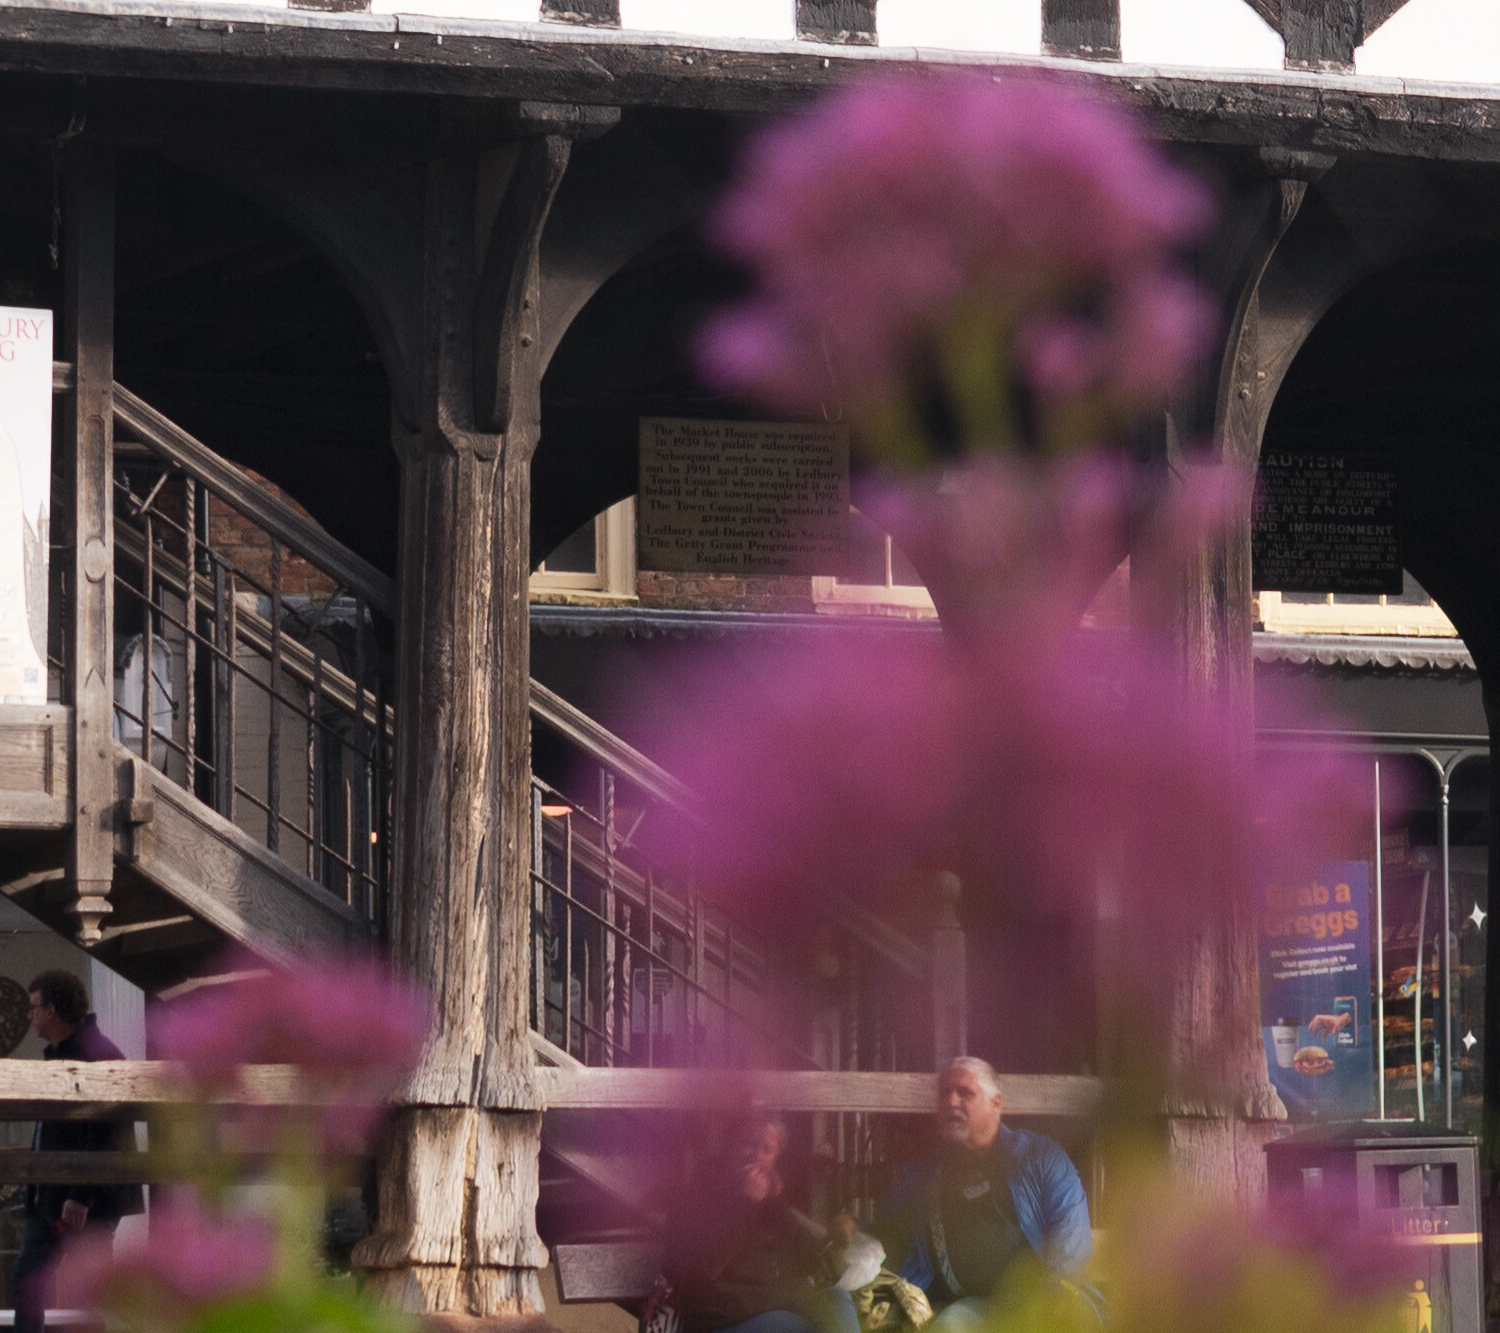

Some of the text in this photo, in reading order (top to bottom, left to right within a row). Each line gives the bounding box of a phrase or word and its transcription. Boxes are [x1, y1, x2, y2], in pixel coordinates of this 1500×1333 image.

[652, 424, 675, 435] The
[680, 426, 720, 438] Market
[724, 428, 759, 439] House
[788, 432, 836, 443] repaired
[655, 435, 667, 446] in
[673, 436, 700, 447] 1939
[704, 438, 716, 450] by
[722, 439, 754, 450] public
[655, 450, 833, 466] Subsequent works were carried
[645, 464, 664, 474] out
[668, 464, 680, 474] in
[686, 464, 711, 475] 1991
[717, 466, 738, 475] and
[743, 466, 773, 477] 2006
[795, 468, 842, 480] Ledbury
[650, 474, 680, 485] Town
[685, 476, 727, 487] Council
[732, 478, 755, 487] who
[645, 485, 682, 496] behalf
[686, 486, 698, 497] of
[702, 488, 719, 498] the
[724, 489, 792, 502] townspeople
[647, 499, 670, 510] The
[675, 500, 705, 511] Town
[709, 502, 752, 513] Council
[758, 506, 776, 514] was
[781, 506, 823, 516] assisted
[1255, 503, 1375, 517] DEMEANOUR
[702, 514, 788, 527] grants given by
[646, 524, 692, 538] Ledbury
[698, 526, 719, 537] and
[723, 527, 764, 537] District
[769, 528, 797, 539] Civic
[1289, 523, 1394, 536] IMPRISONMENT
[647, 536, 670, 548] The
[675, 538, 705, 550] Getty
[711, 539, 743, 550] Grant
[696, 553, 738, 565] English
[1268, 549, 1307, 559] PLACE
[1335, 882, 1351, 904] a
[1264, 909, 1359, 939] Greggs
